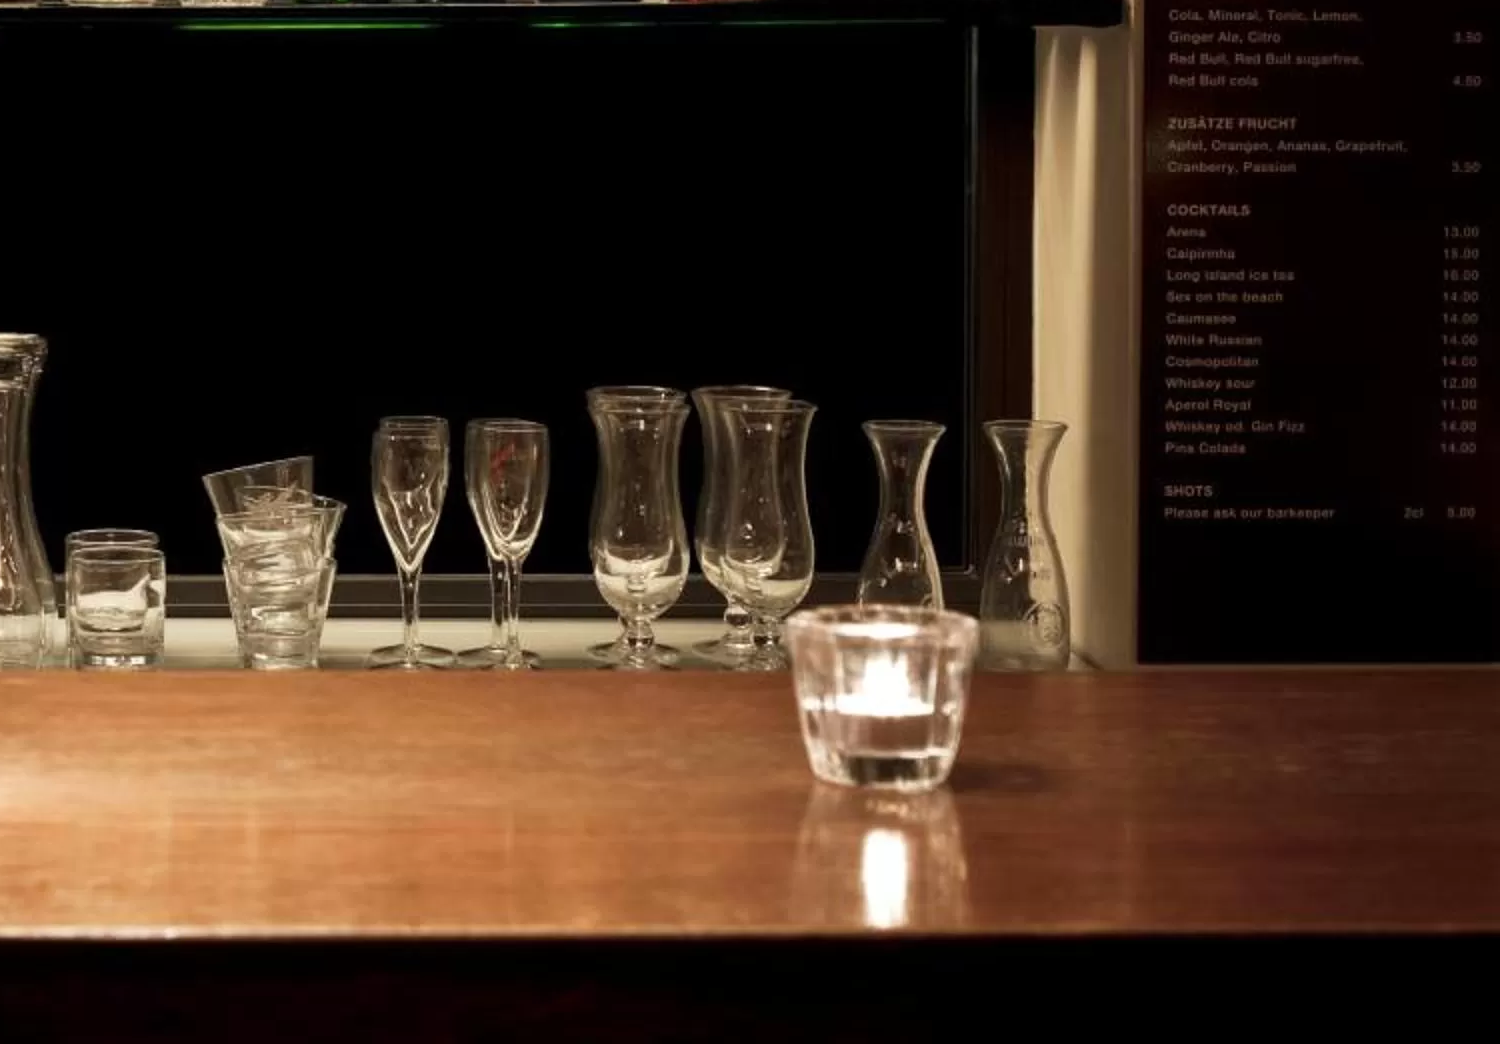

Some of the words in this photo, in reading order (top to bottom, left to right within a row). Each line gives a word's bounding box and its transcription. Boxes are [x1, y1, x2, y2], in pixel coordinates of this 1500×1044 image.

[1239, 118, 1298, 129] FRUCHT
[1167, 205, 1251, 216] COCKTAILS
[1164, 486, 1213, 497] SHOTS
